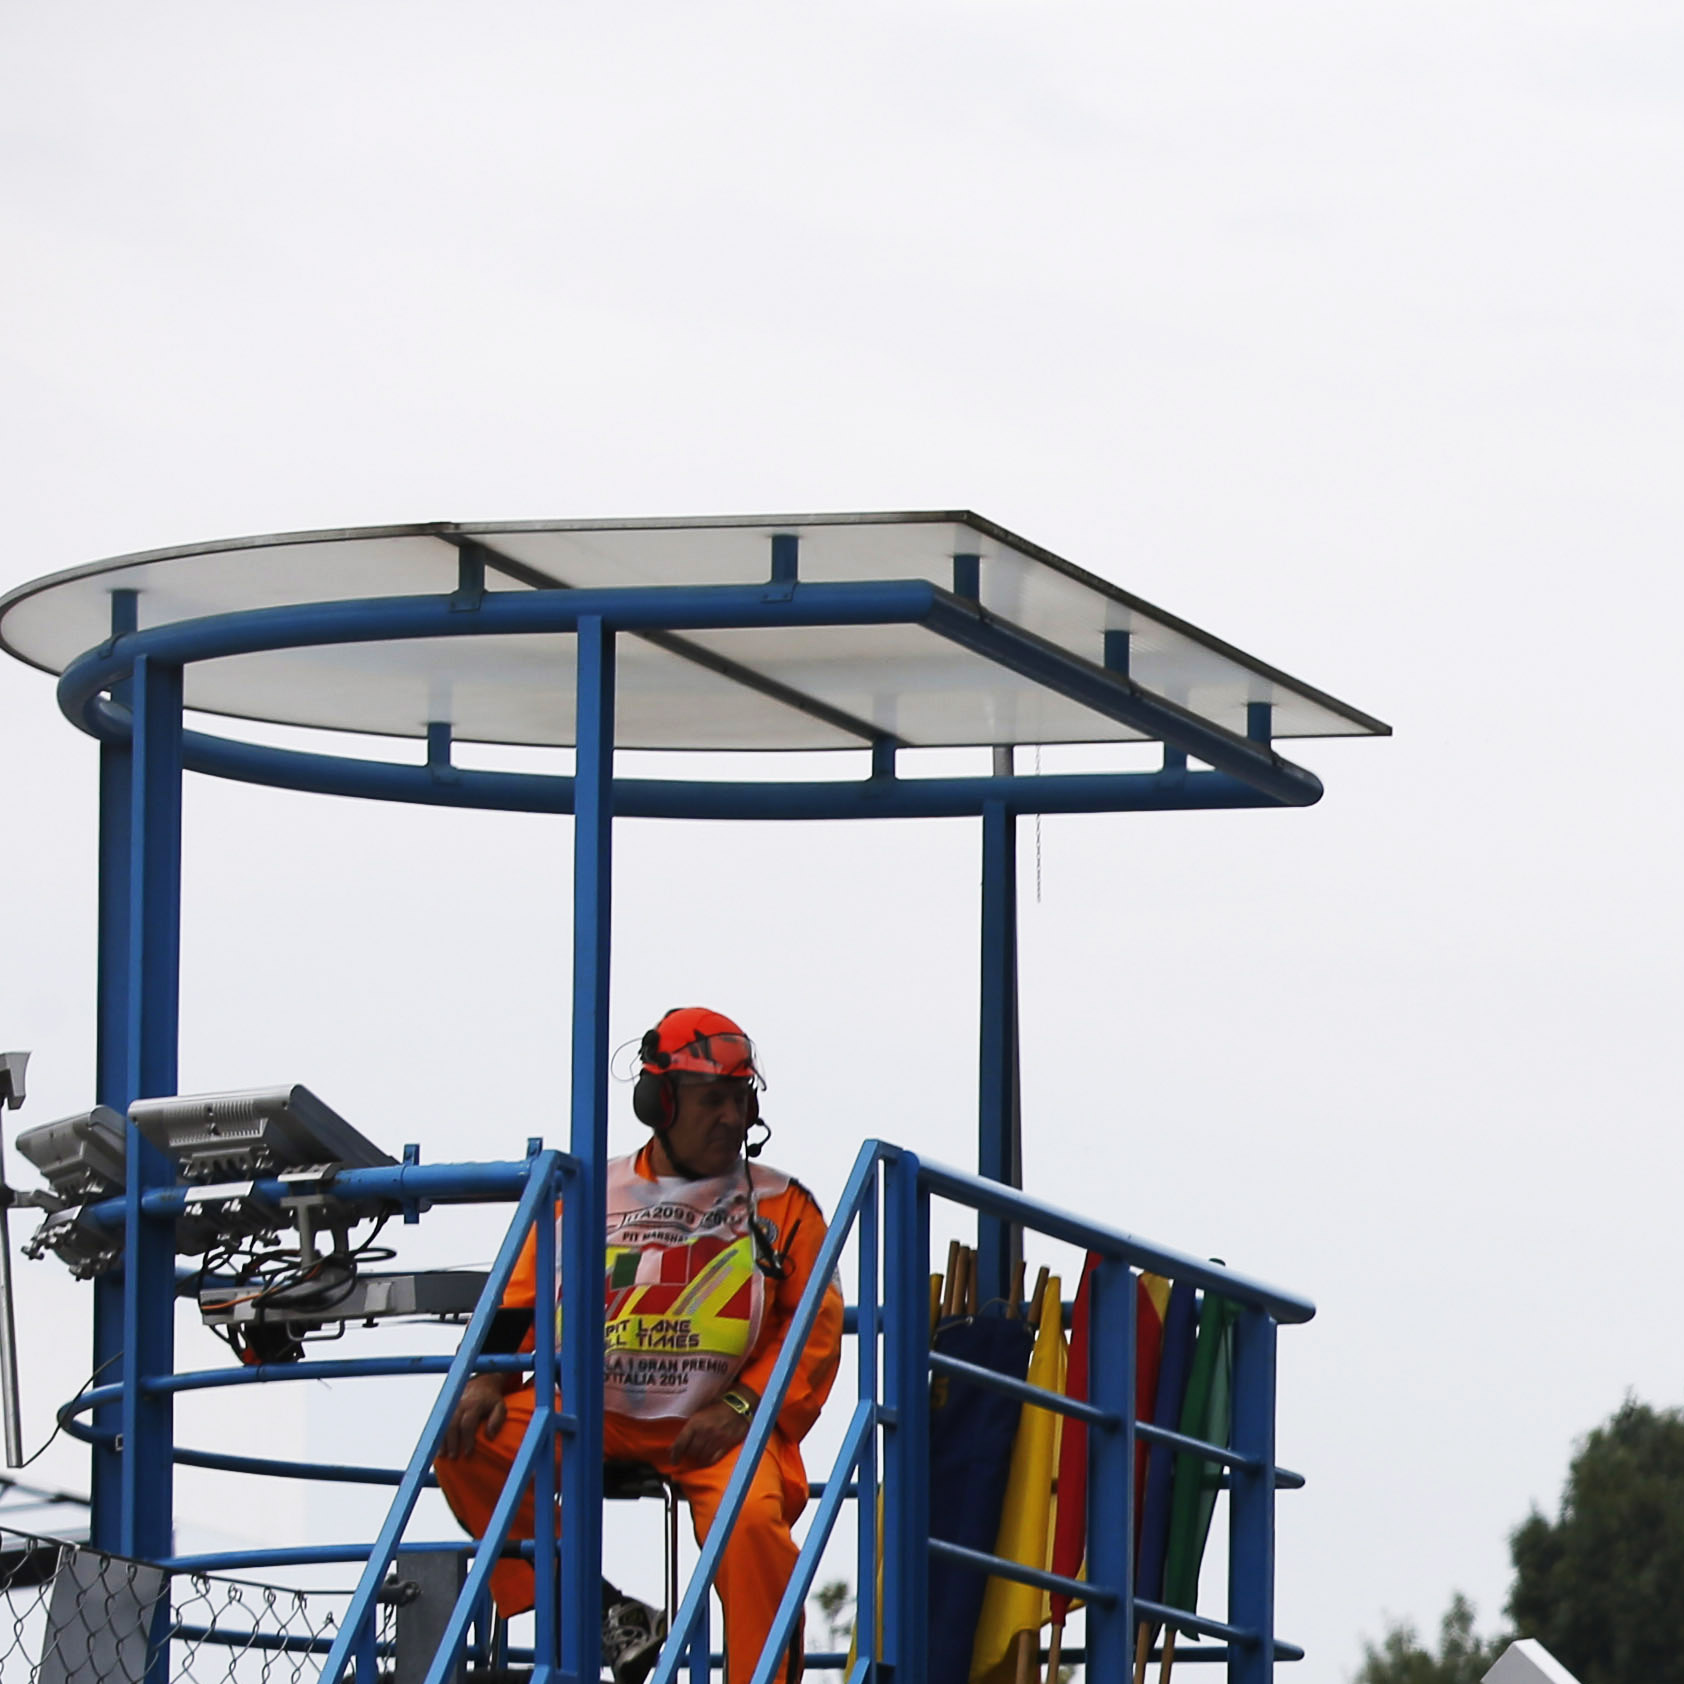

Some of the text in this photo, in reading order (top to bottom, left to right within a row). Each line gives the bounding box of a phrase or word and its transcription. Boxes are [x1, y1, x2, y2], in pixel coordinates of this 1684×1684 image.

[623, 1231, 639, 1242] PIT
[605, 1318, 692, 1337] PIT LANE
[637, 1333, 700, 1348] TIMES
[638, 1359, 678, 1373] GRAN
[681, 1358, 729, 1376] PREMIO
[660, 1372, 689, 1387] 2014
